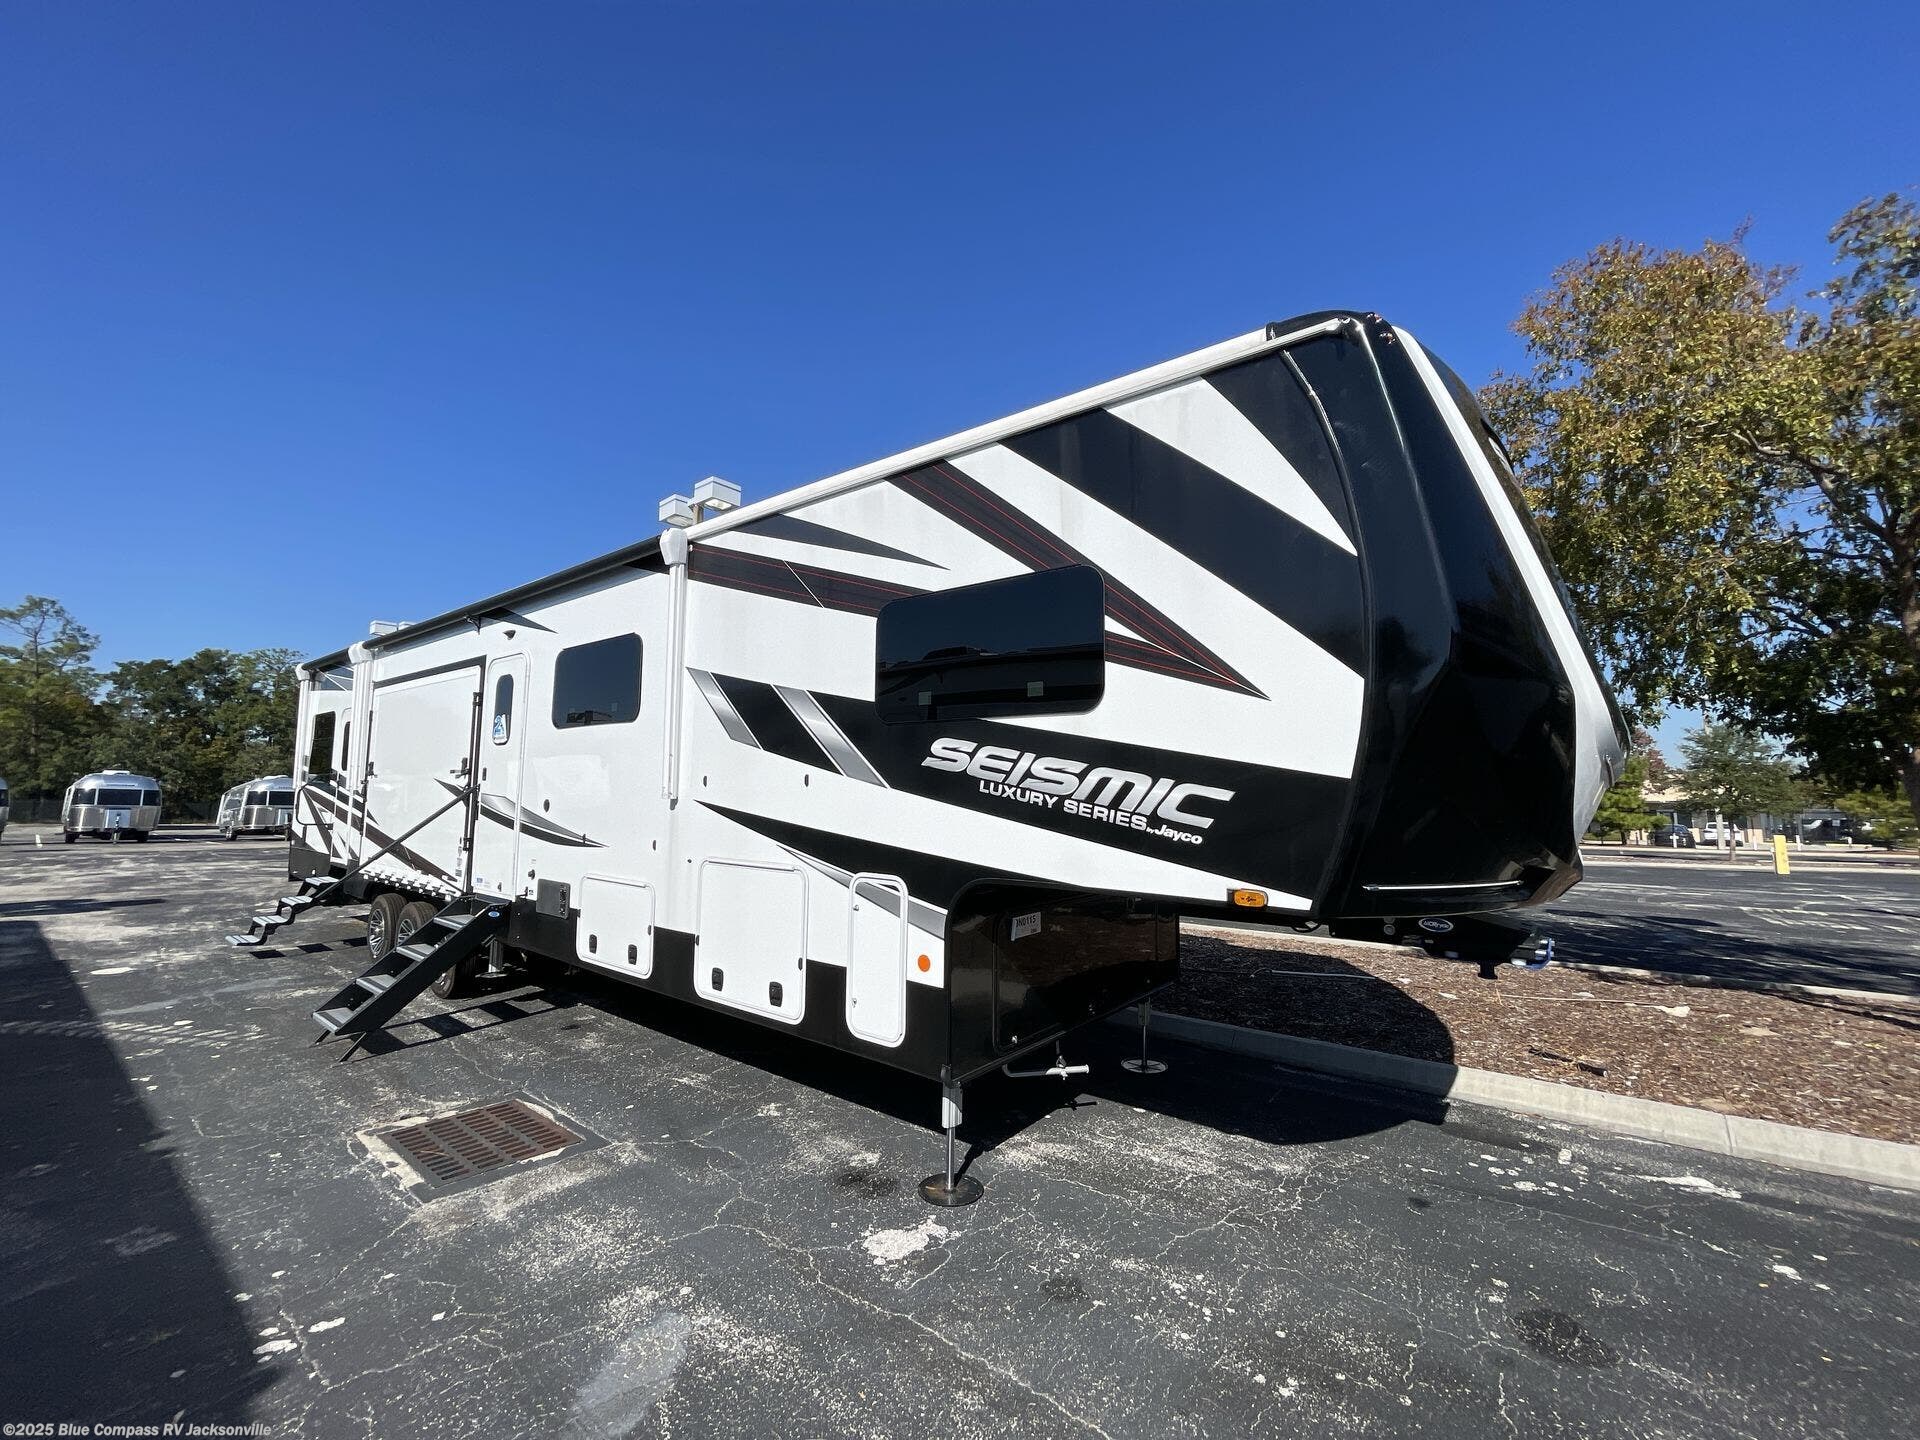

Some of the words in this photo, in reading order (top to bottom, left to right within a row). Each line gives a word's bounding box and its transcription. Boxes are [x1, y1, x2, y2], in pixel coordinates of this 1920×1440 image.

[921, 737, 1236, 829] SEISMIC
[979, 780, 1059, 809] LUXURY
[1063, 799, 1148, 832] SERIES
[1154, 824, 1203, 844] Jayco
